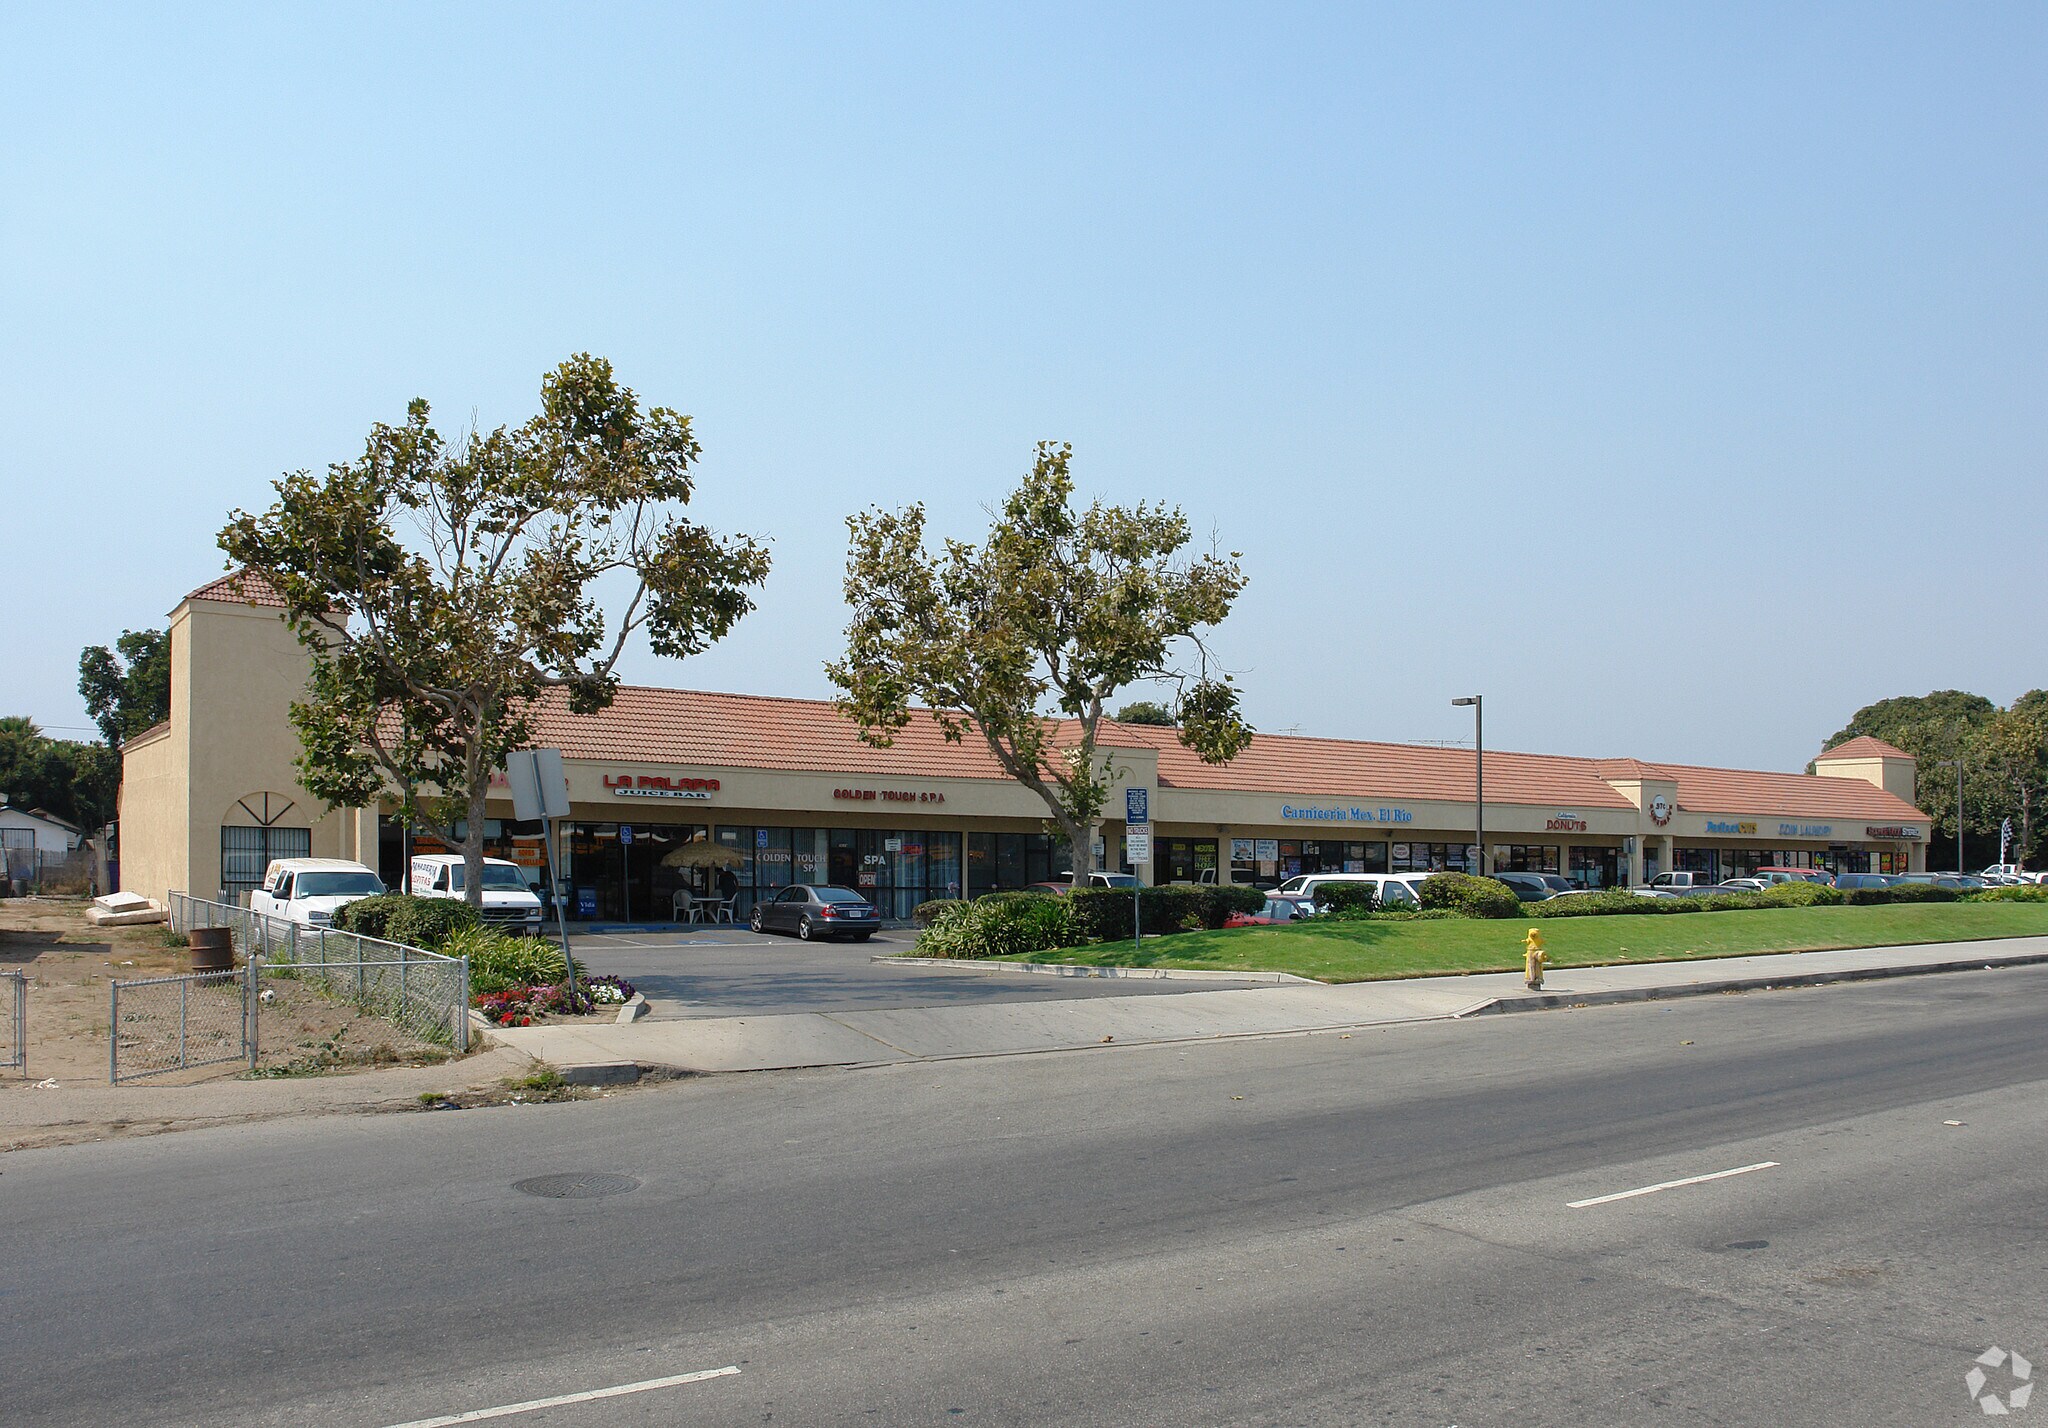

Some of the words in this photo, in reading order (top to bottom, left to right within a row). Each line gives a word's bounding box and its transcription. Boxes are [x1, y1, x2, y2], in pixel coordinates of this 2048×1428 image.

[603, 774, 632, 789] LA
[638, 775, 720, 791] PALAPA
[619, 789, 669, 797] JUICE
[673, 791, 707, 799] BAR
[833, 788, 876, 800] GOLDEN
[881, 790, 916, 801] TOUCH
[920, 792, 945, 803] SPA
[1350, 807, 1375, 821] Mex.
[1378, 808, 1390, 821] El
[1546, 819, 1587, 831] DONUTS
[1779, 824, 1797, 835] COIN
[796, 853, 827, 863] TOUCH
[863, 855, 886, 865] SPA
[803, 863, 819, 872] SPA
[859, 872, 876, 884] OPEN
